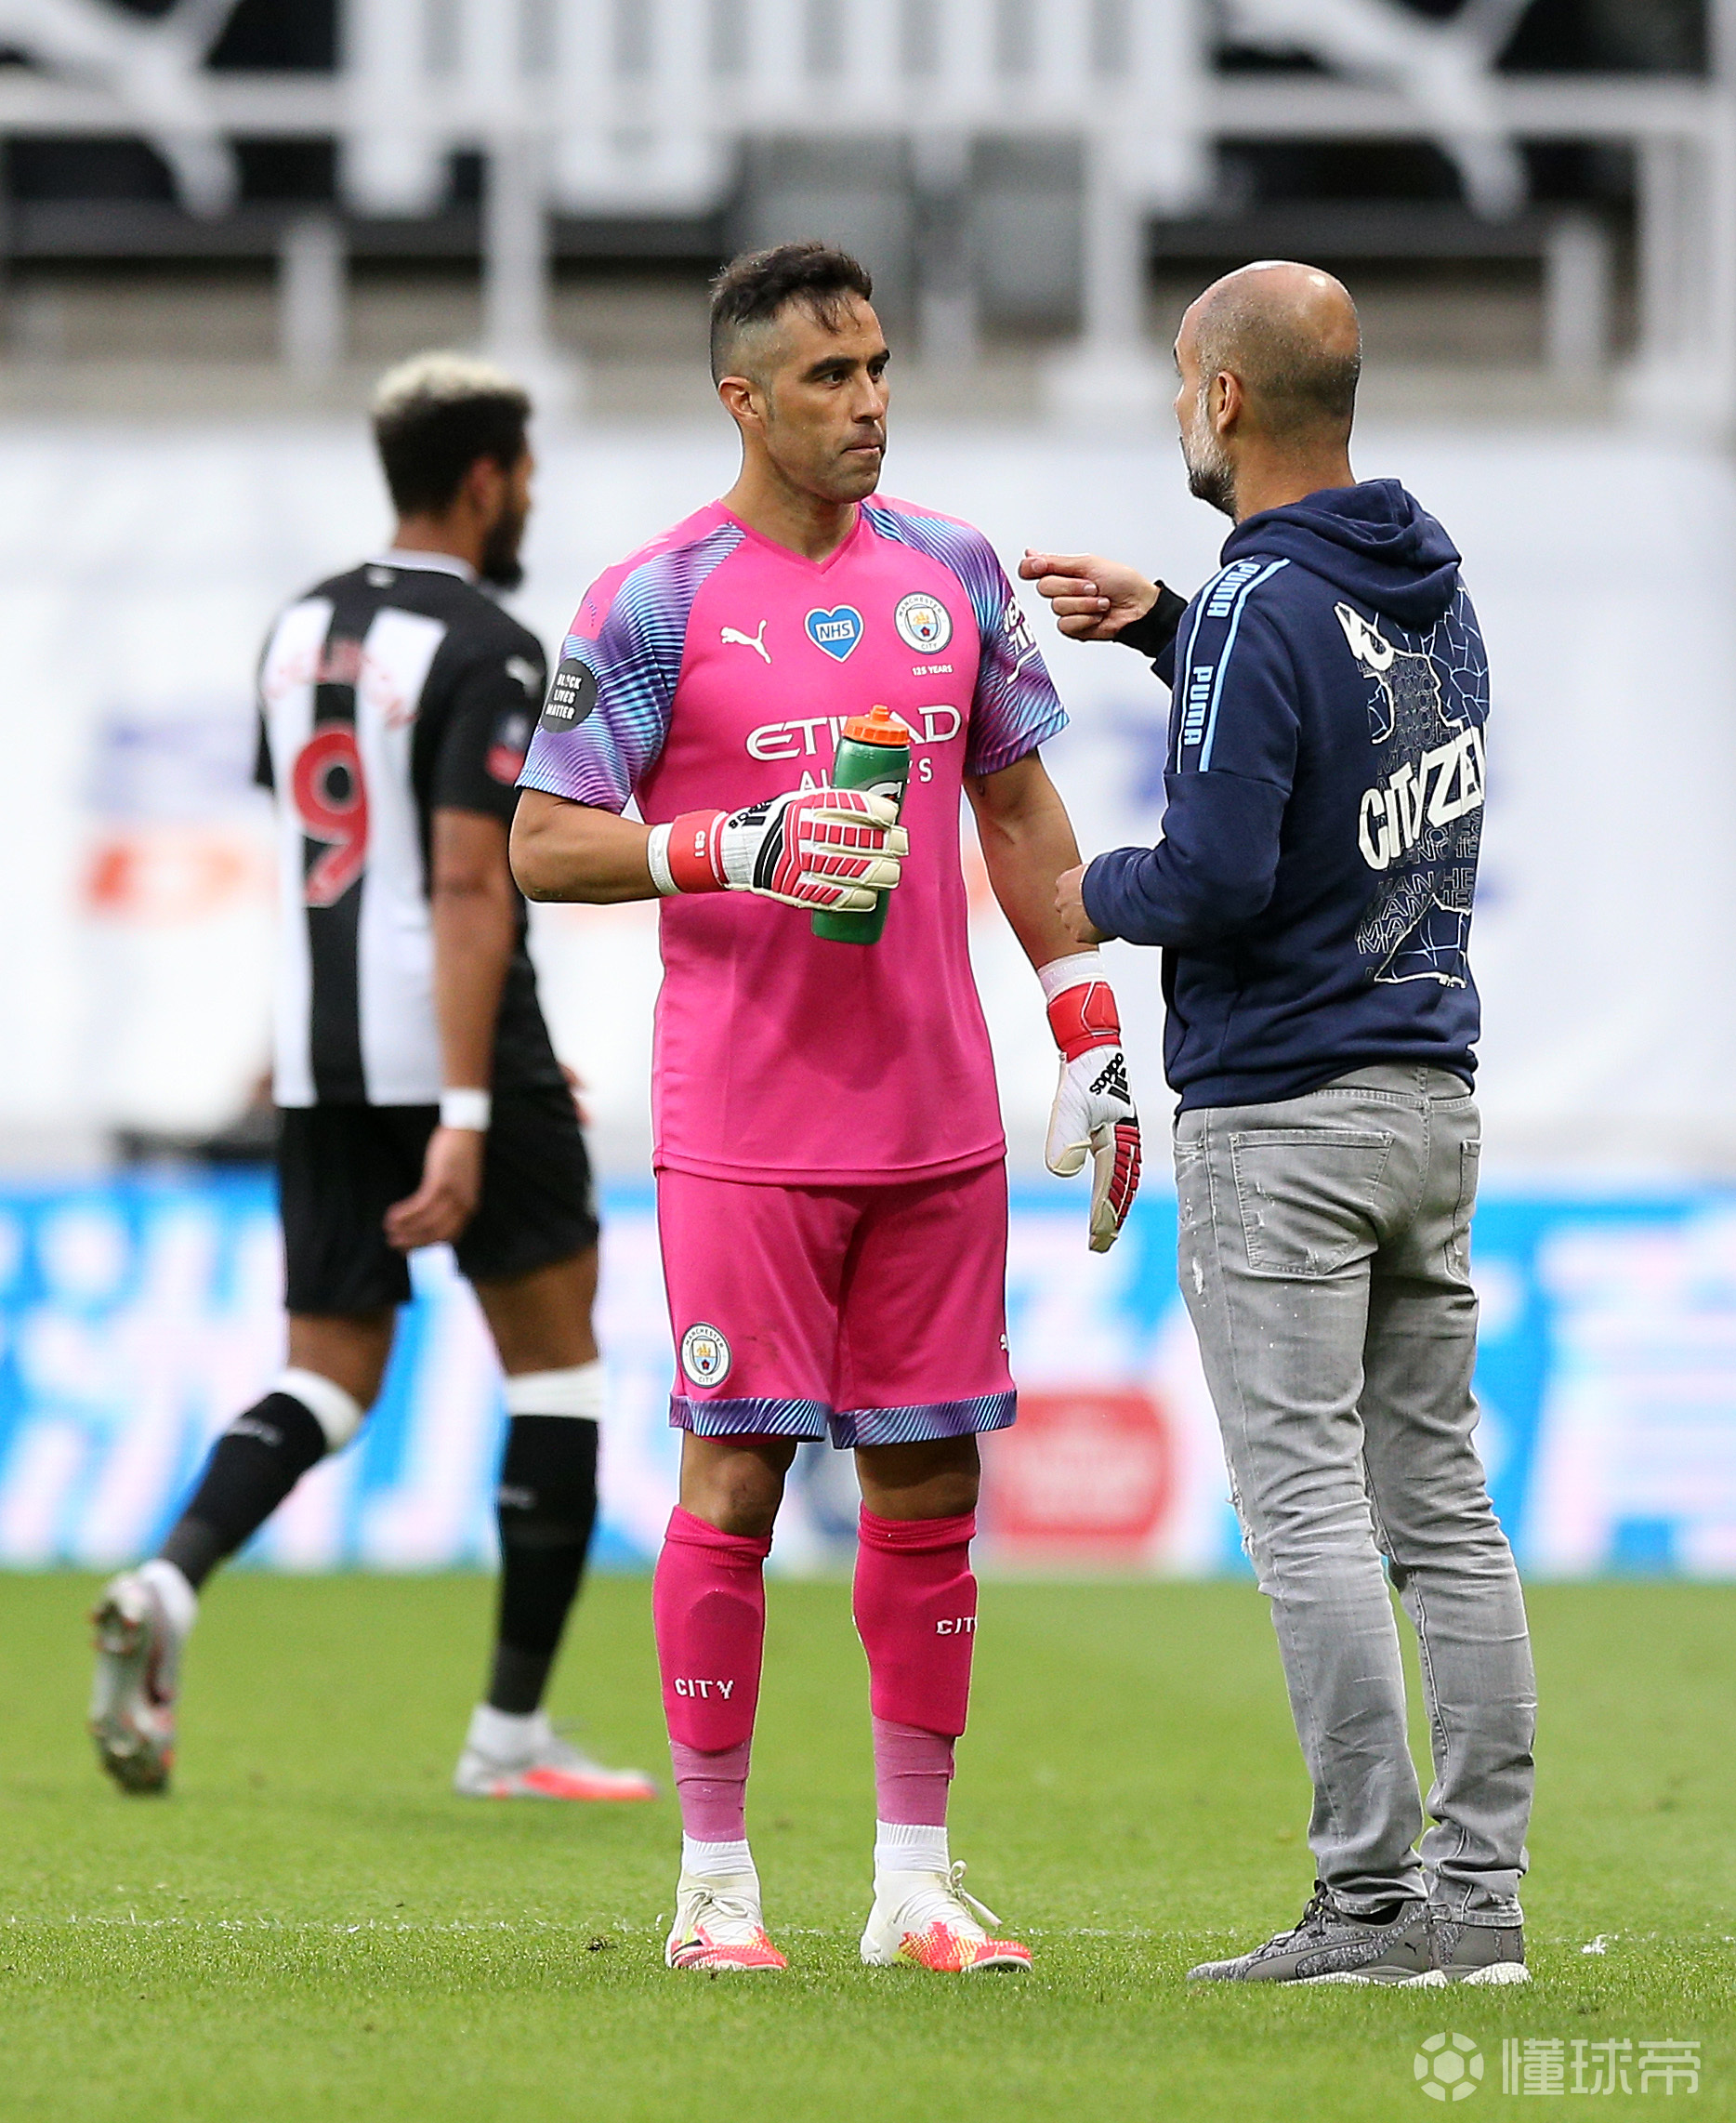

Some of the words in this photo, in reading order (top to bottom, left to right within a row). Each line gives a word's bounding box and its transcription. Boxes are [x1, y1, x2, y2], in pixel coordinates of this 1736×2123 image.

[1207, 562, 1261, 617] PUMA
[899, 597, 942, 617] MANCHESTER
[820, 622, 851, 640] NHS
[912, 666, 927, 676] 125
[927, 665, 953, 674] YEARS
[557, 673, 582, 690] BLACK
[553, 689, 576, 704] LIVES
[1184, 666, 1214, 745] PUMA
[546, 703, 575, 720] MATTER
[746, 705, 962, 761] ETIAD
[292, 727, 370, 908] 9
[694, 830, 706, 858] CB1
[686, 1328, 724, 1348] MANCHESTER
[936, 1616, 978, 1635] CIT
[675, 1678, 734, 1700] CITY
